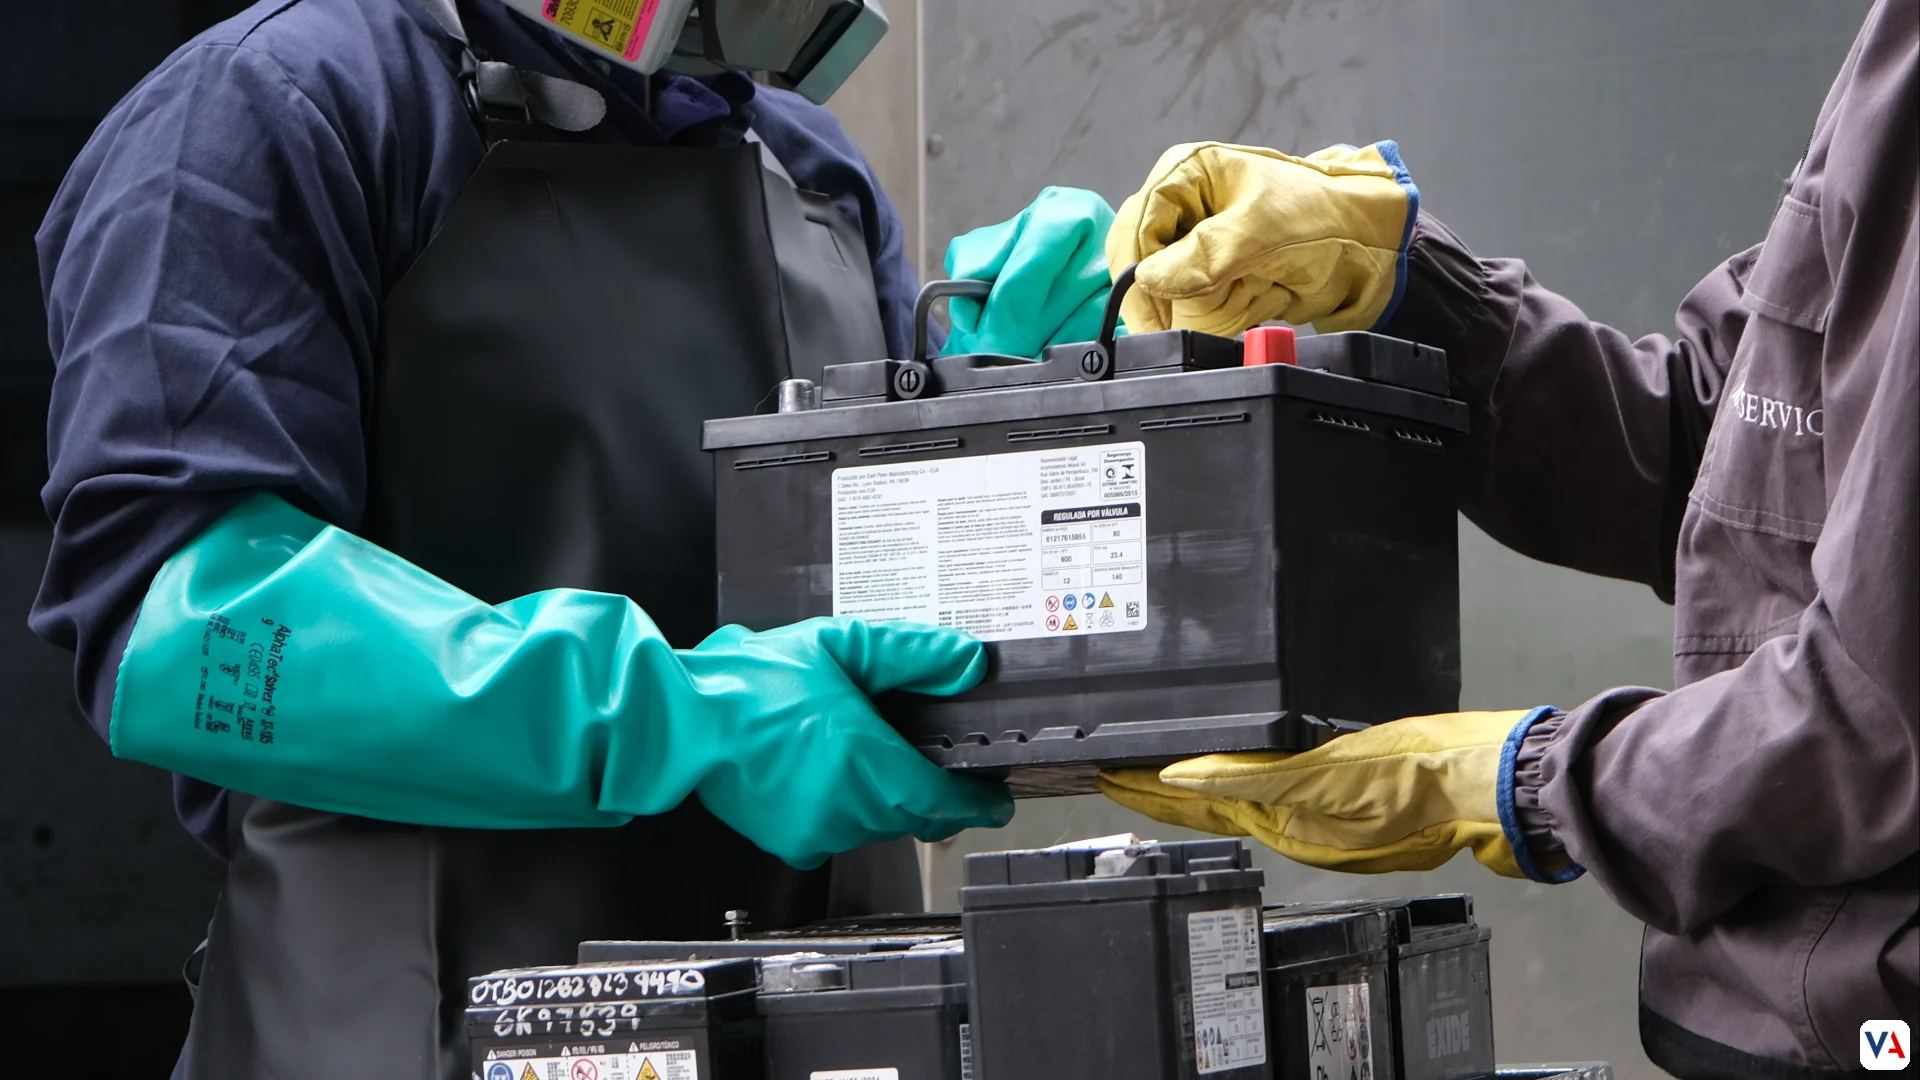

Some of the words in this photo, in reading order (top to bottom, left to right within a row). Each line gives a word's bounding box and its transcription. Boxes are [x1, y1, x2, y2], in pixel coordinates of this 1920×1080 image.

[1053, 510, 1086, 521] REGULADA
[1087, 509, 1100, 519] POR
[1101, 507, 1128, 518] VÁLVULA
[1427, 1010, 1470, 1059] EXIDE
